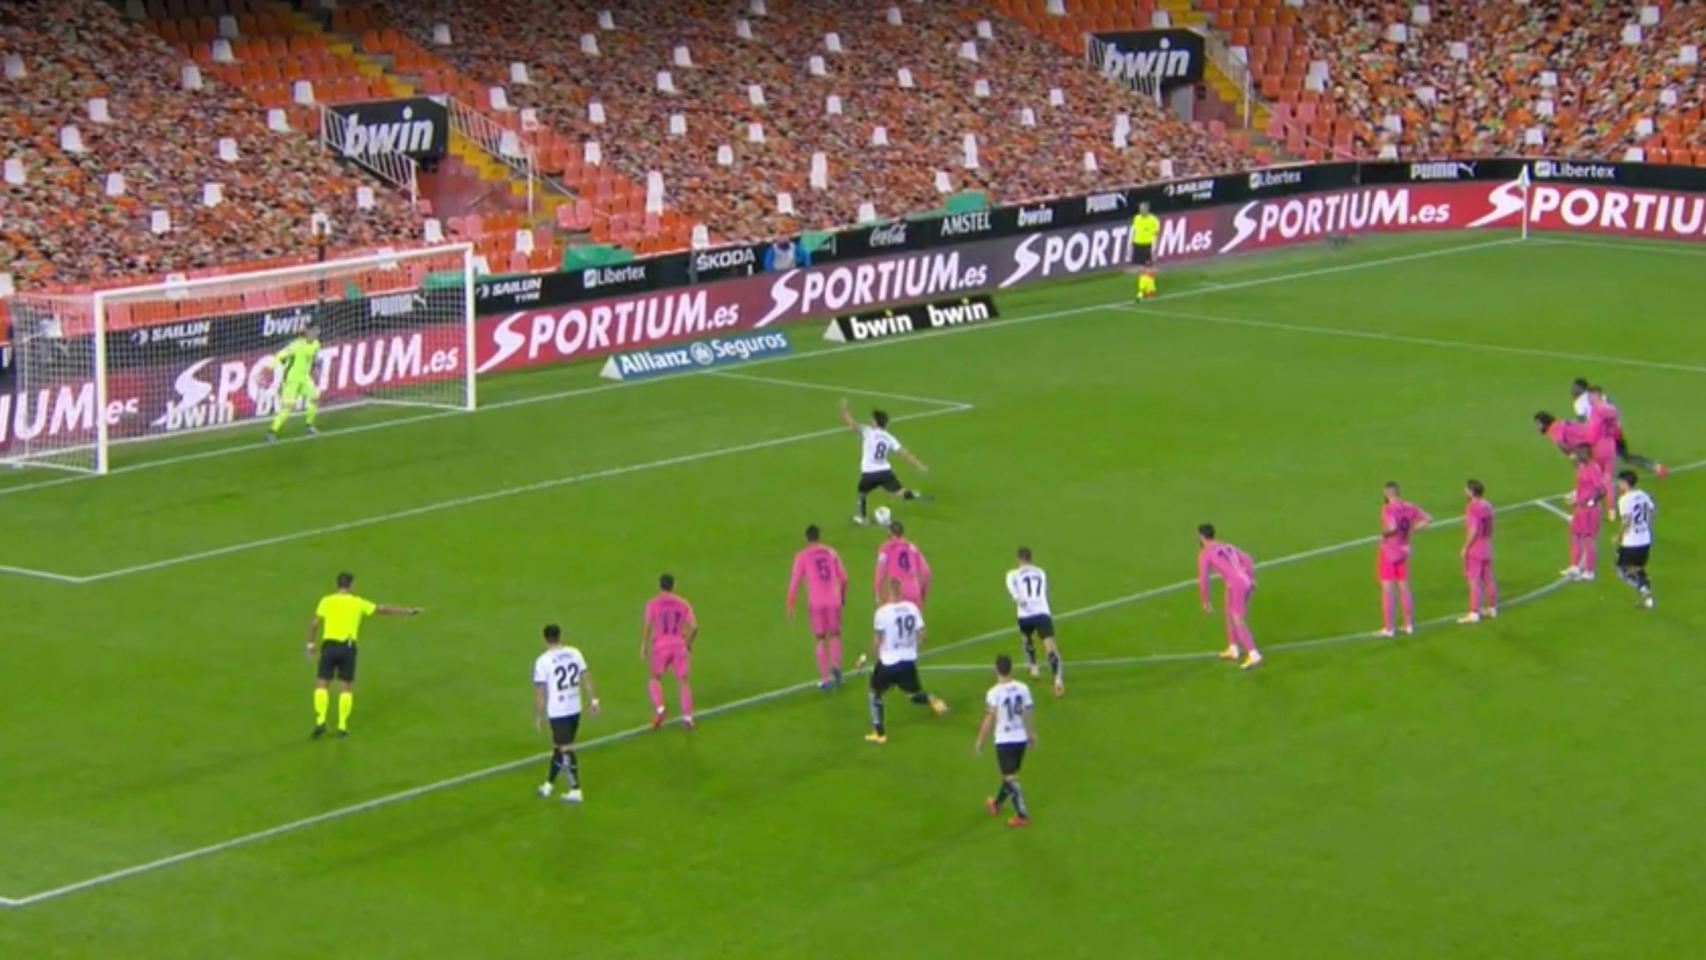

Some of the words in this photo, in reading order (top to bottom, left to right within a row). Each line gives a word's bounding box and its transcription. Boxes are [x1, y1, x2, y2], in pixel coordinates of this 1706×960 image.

[1104, 37, 1190, 79] bwin
[343, 106, 434, 157] bwin
[1259, 170, 1302, 187] Libertex
[1410, 162, 1458, 180] PUMA
[1553, 161, 1616, 179] Libertex
[1017, 203, 1053, 228] bwin
[1465, 178, 1706, 235] SPORTIU
[941, 211, 992, 237] AMSTEL
[1218, 188, 1450, 254] SPORTIUM.es
[998, 216, 1213, 289] SPORTIM.es
[492, 276, 542, 297] SAILUN
[598, 264, 646, 289] Libertex
[753, 251, 988, 328] SPORTIUM.es
[475, 290, 739, 373] SPORTIUM.es
[850, 309, 913, 340] bwin
[927, 298, 989, 327] bwin
[621, 349, 692, 376] Allianz
[711, 332, 788, 361] Seguros
[150, 333, 459, 427] SPOTIUM.es
[874, 441, 888, 461] 8
[815, 557, 832, 582] 5
[1022, 576, 1043, 598] 17
[895, 614, 916, 639] 19
[554, 662, 579, 691] 22
[1003, 694, 1023, 720] 14
